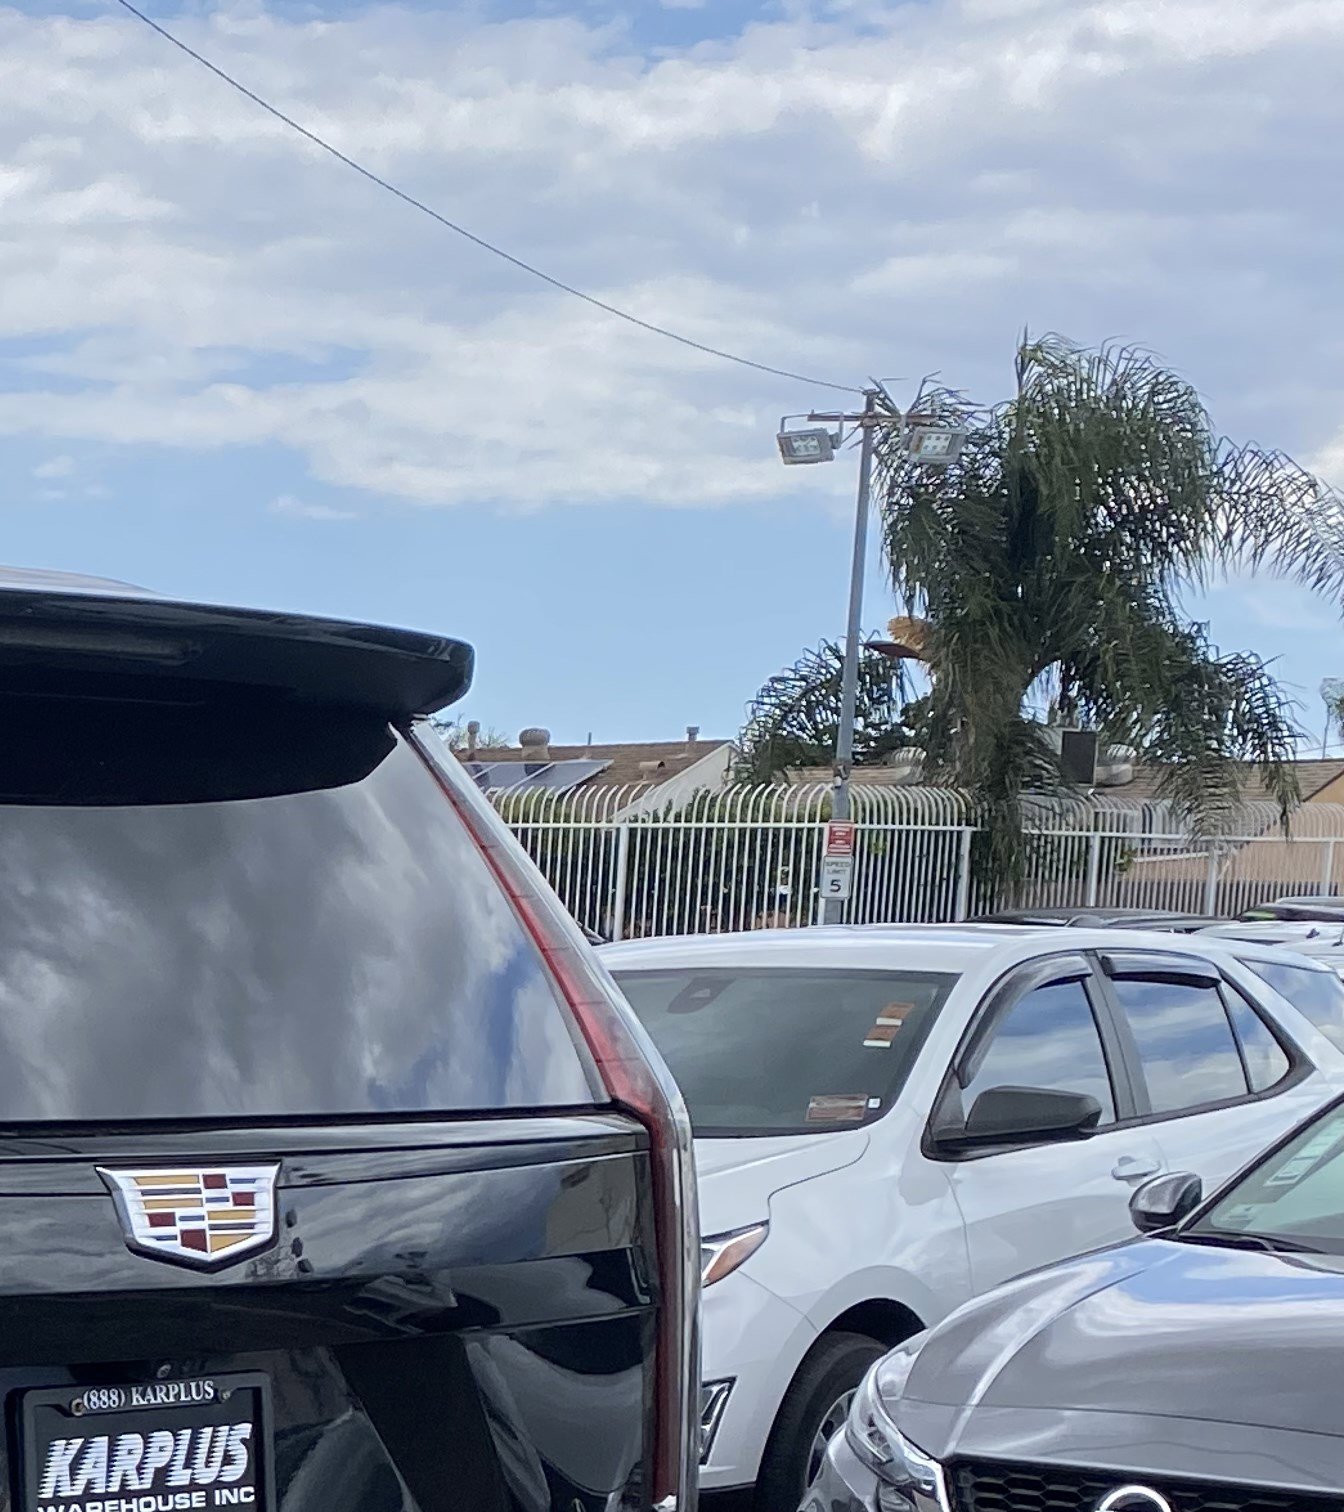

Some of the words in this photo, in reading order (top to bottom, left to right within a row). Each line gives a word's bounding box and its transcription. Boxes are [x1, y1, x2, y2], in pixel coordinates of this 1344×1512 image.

[830, 879, 841, 893] 5
[83, 1389, 125, 1410] (888)
[131, 1380, 214, 1407] KARPLUS
[37, 1422, 253, 1499] KARPLUS
[214, 1486, 256, 1506] INC
